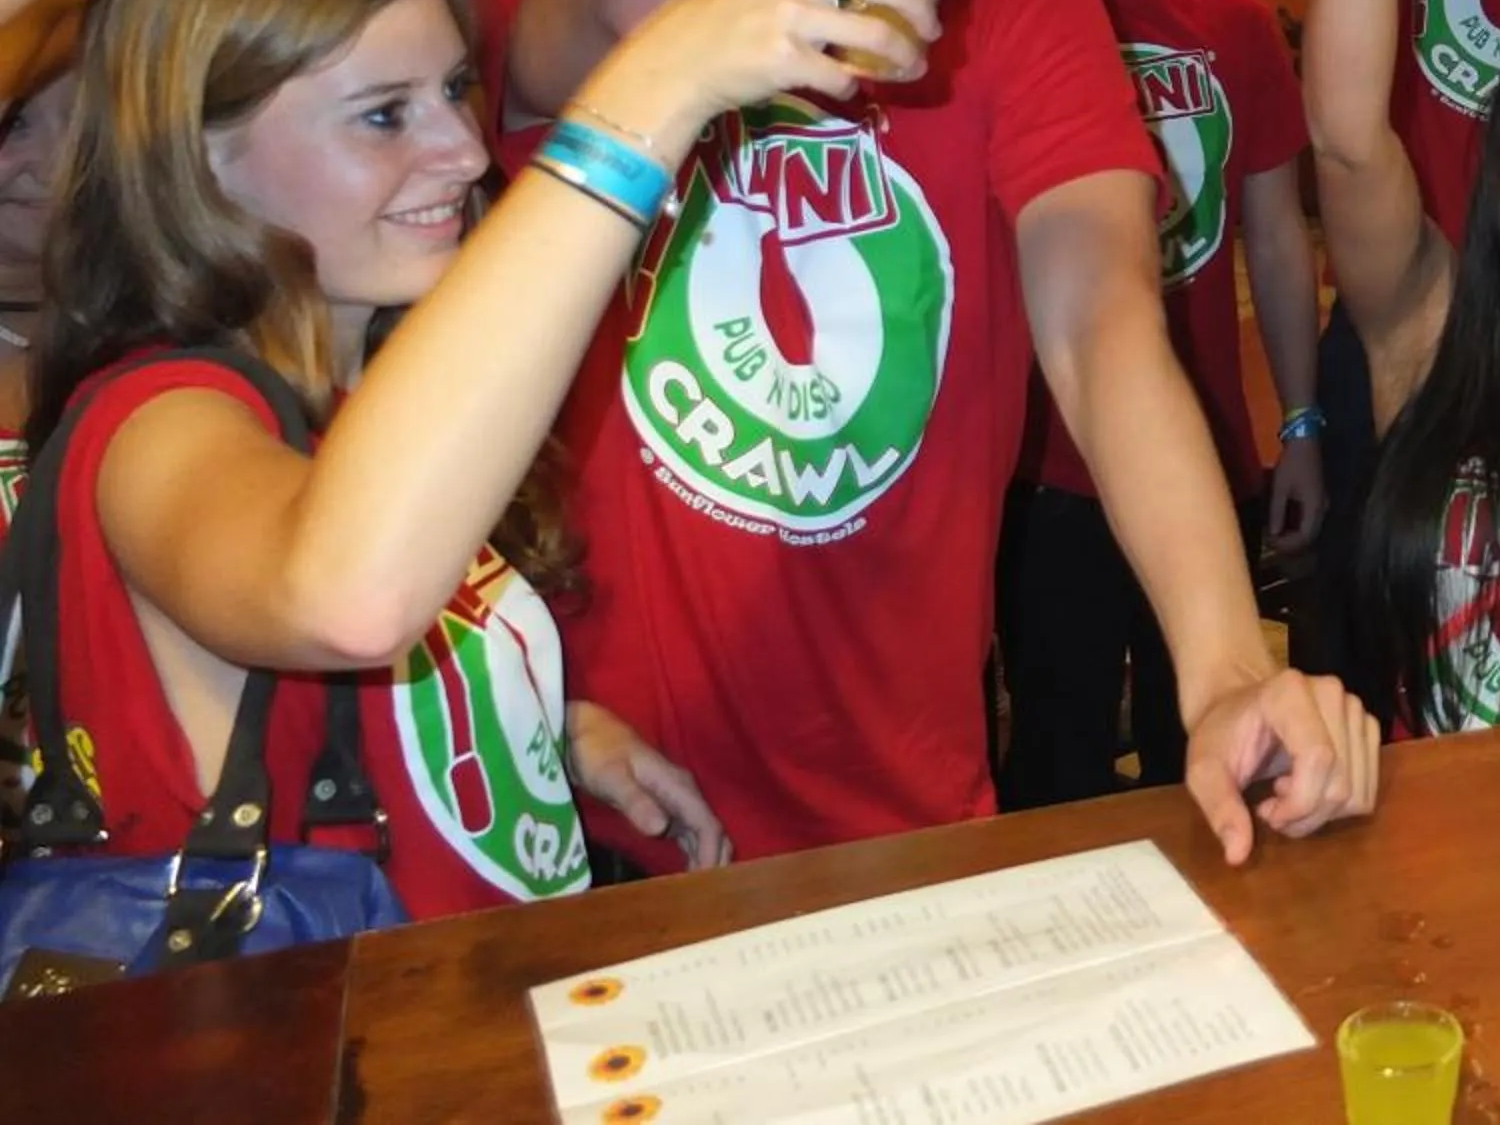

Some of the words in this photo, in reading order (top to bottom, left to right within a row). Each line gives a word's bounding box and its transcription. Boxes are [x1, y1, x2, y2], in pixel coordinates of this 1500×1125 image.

[1459, 16, 1491, 49] PUB
[713, 316, 767, 382] PUB
[787, 371, 842, 421] DISO
[648, 359, 900, 507] CRAWL
